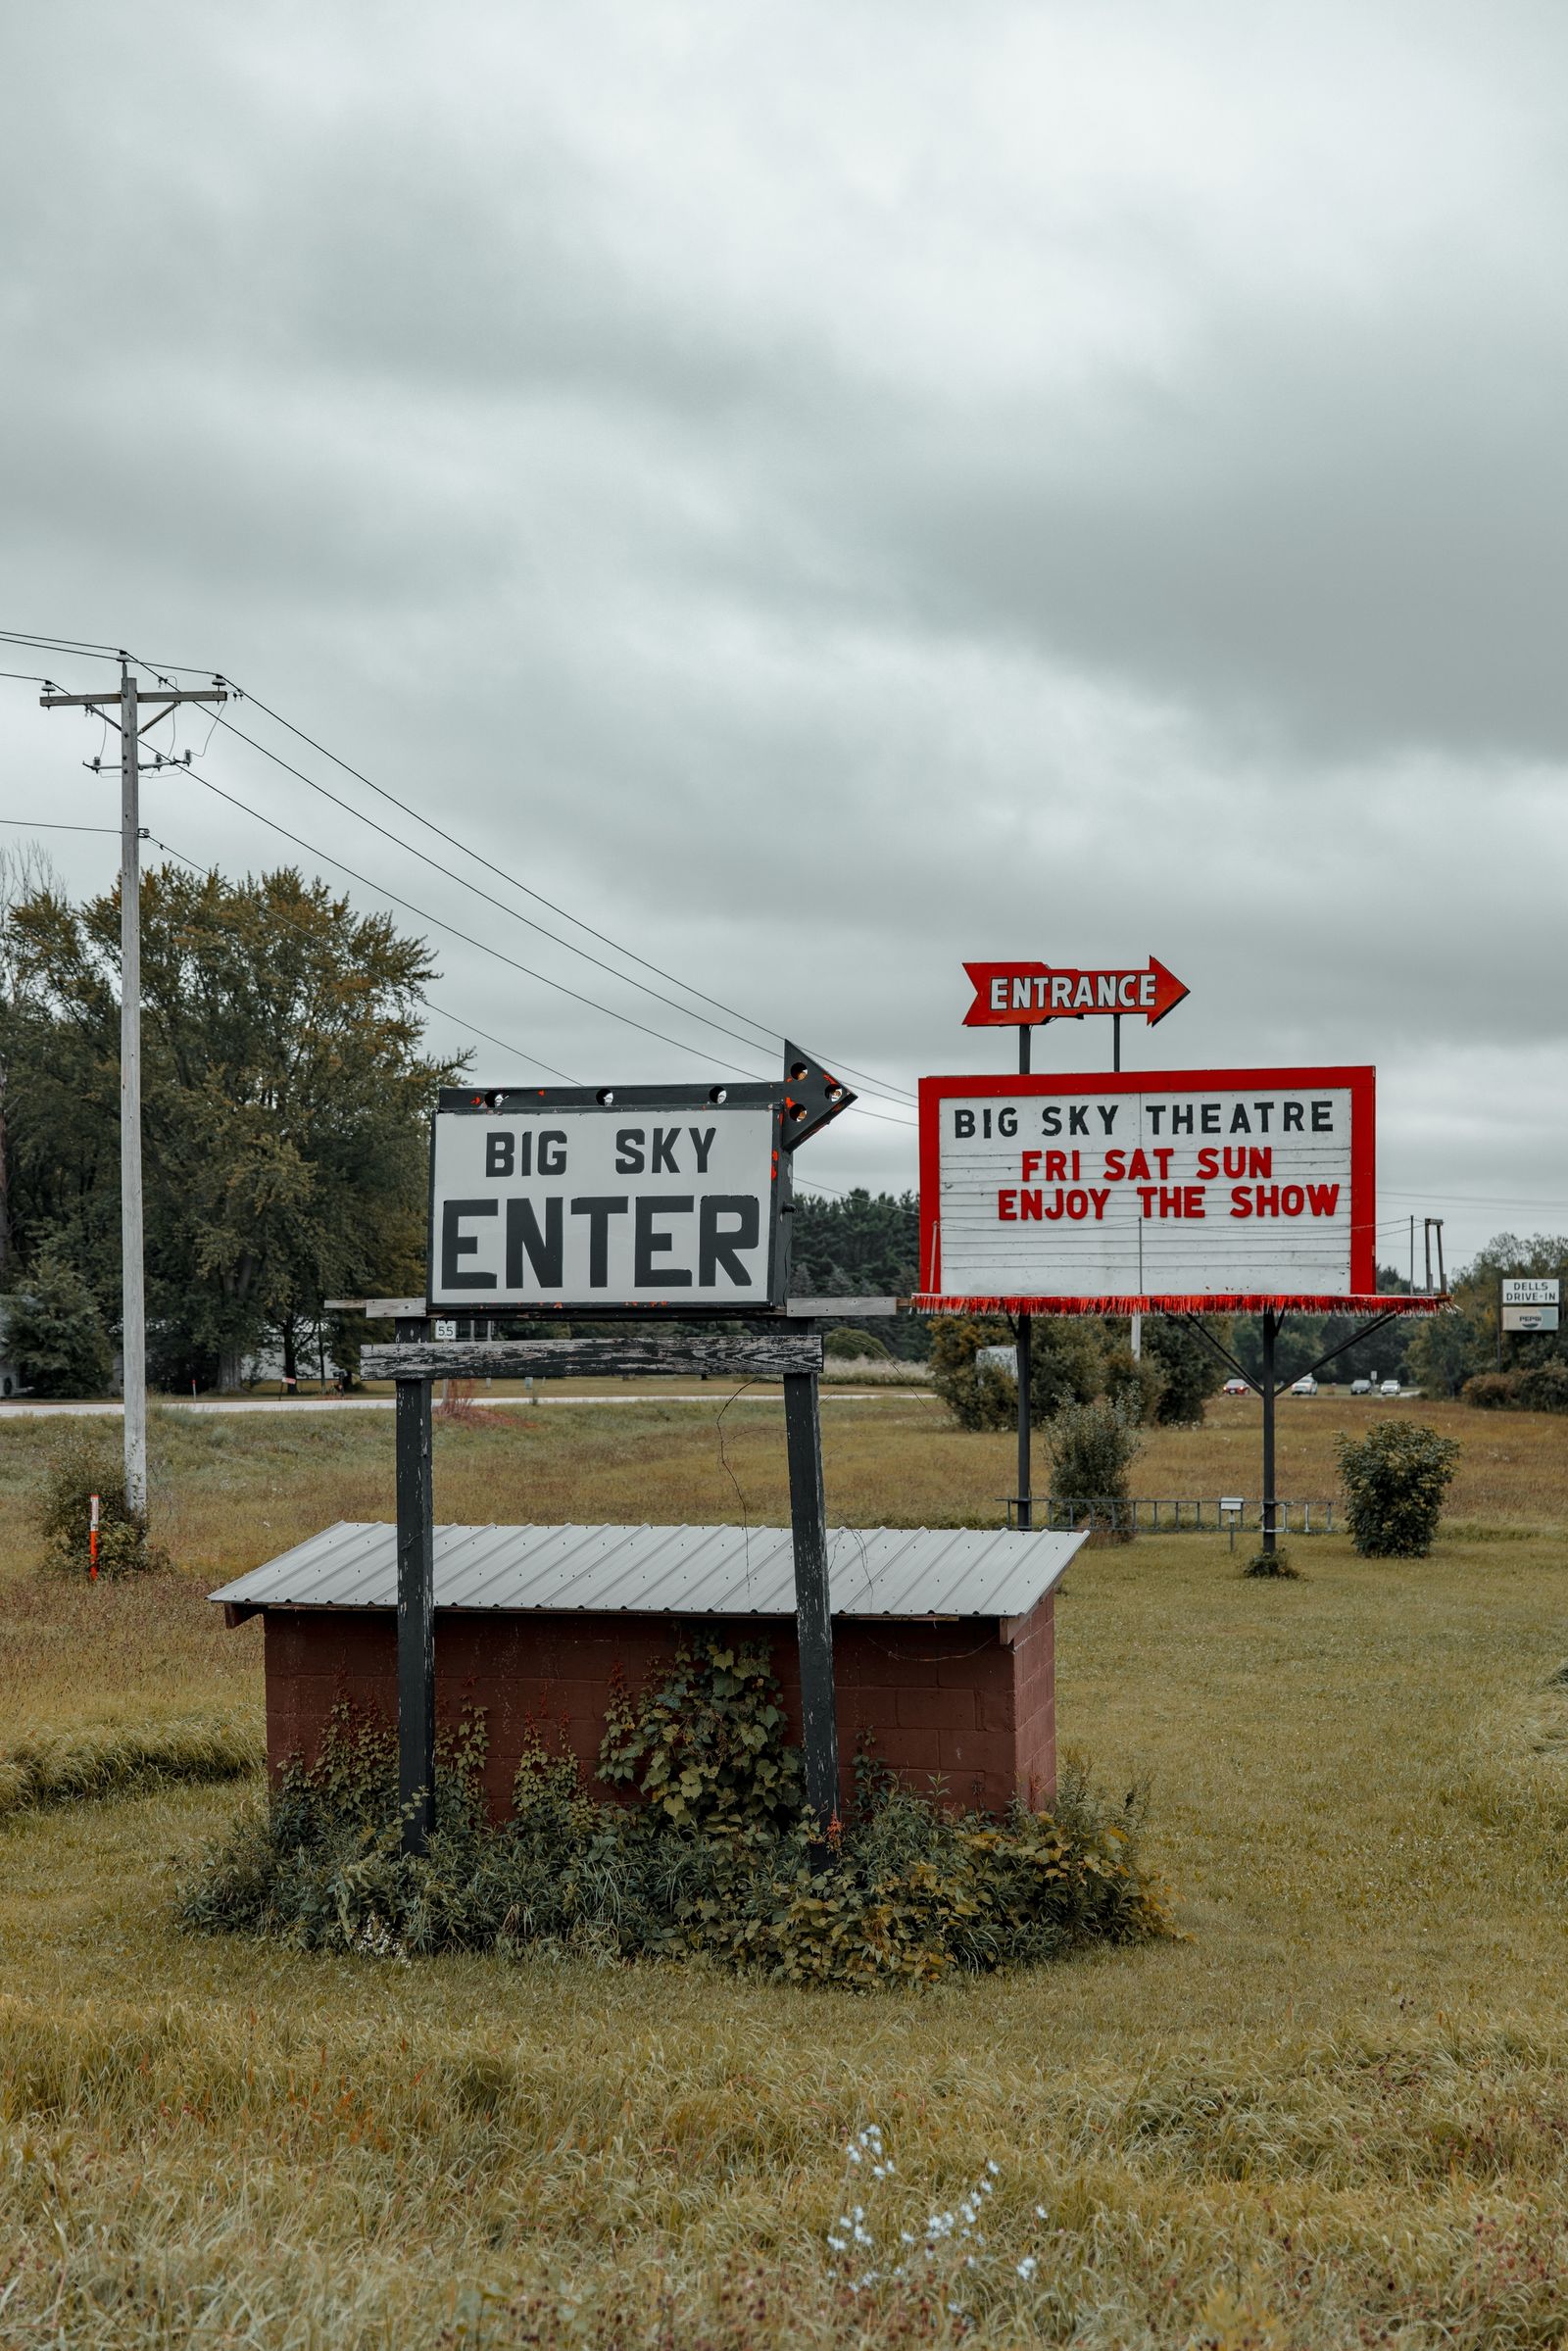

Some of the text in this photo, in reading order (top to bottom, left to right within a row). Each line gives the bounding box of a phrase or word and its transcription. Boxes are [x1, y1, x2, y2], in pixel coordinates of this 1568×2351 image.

[990, 974, 1157, 1011] ENTRANCE
[955, 1101, 1334, 1139] BIG SKY THEATRE
[486, 1127, 716, 1178] BIG SKY
[1021, 1147, 1272, 1182] FRI SAT SUN
[998, 1184, 1340, 1221] ENJOY THE SHOW
[441, 1195, 760, 1290] ENTER
[1506, 1293, 1556, 1301] DRIVE-IN
[1513, 1282, 1548, 1291] DELLS
[438, 1326, 454, 1337] 55
